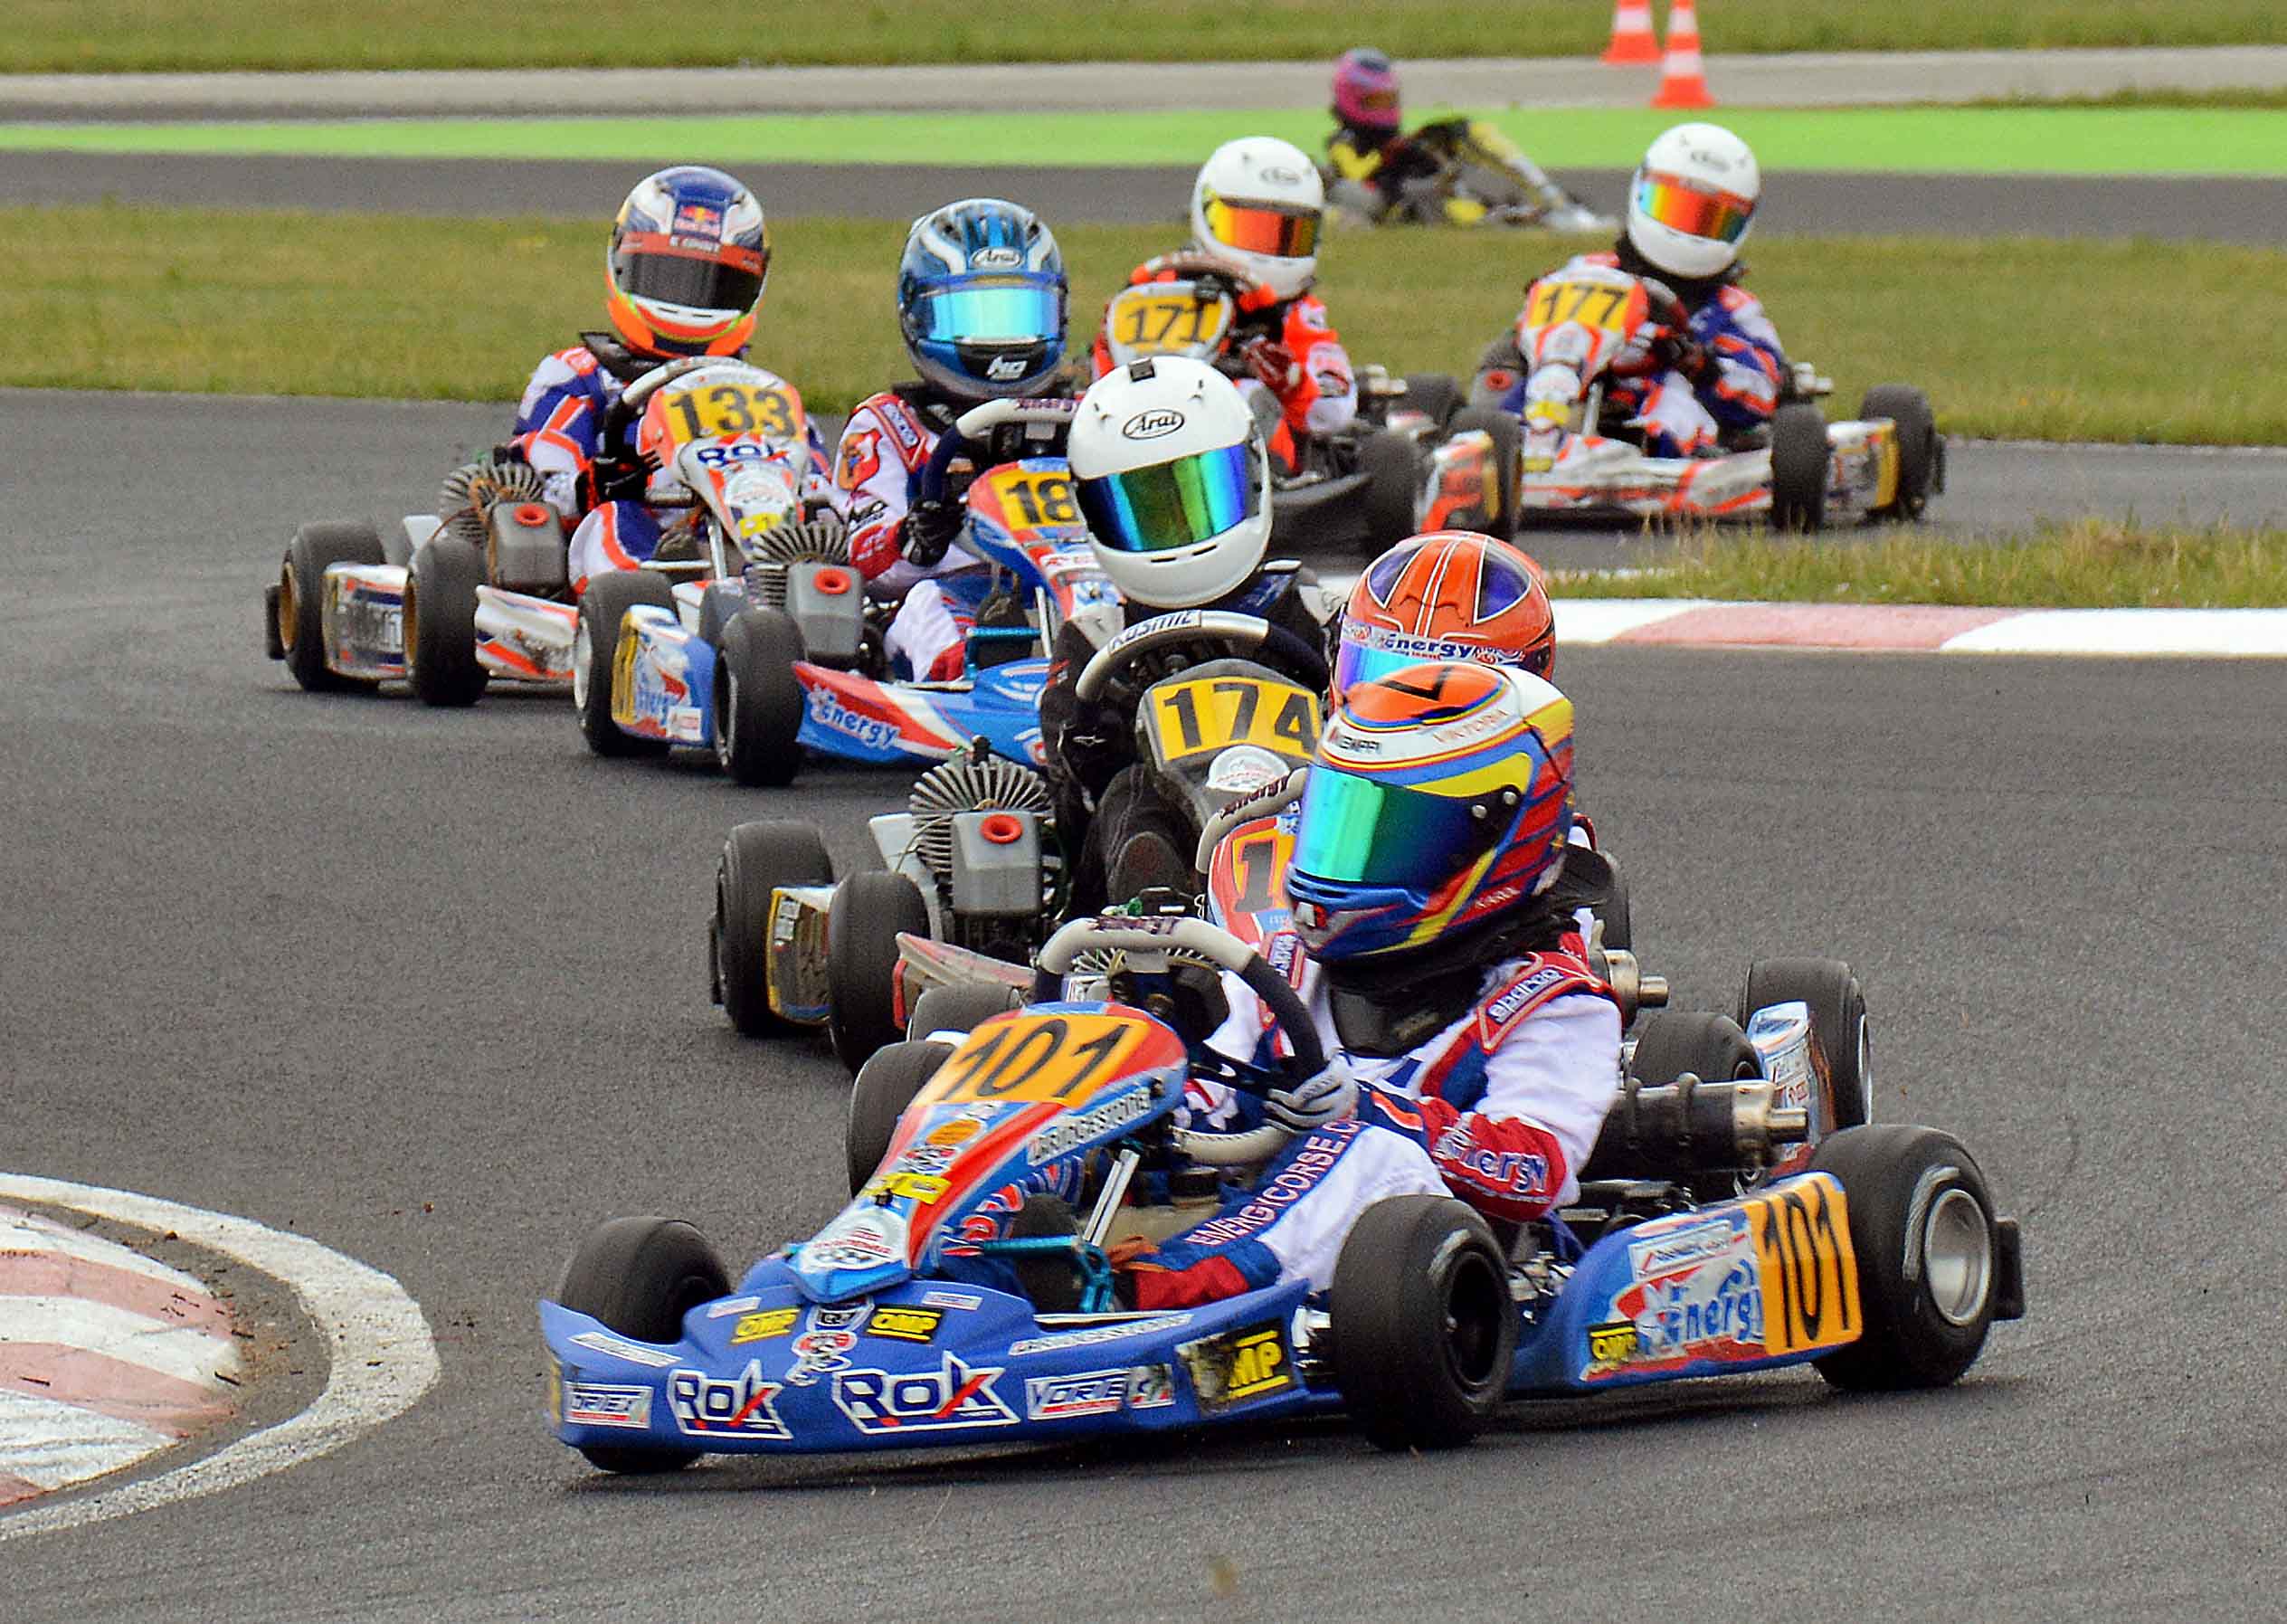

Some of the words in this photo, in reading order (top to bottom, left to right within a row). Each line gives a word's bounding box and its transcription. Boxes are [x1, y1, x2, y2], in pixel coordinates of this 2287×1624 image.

[1125, 299, 1207, 344] 171
[1540, 285, 1627, 326] 177
[671, 387, 795, 438] 133
[1131, 415, 1177, 434] Arai
[1163, 683, 1317, 753] 174
[937, 1020, 1132, 1098] 101
[1763, 1180, 1850, 1348] 101
[1229, 1342, 1282, 1388] MP
